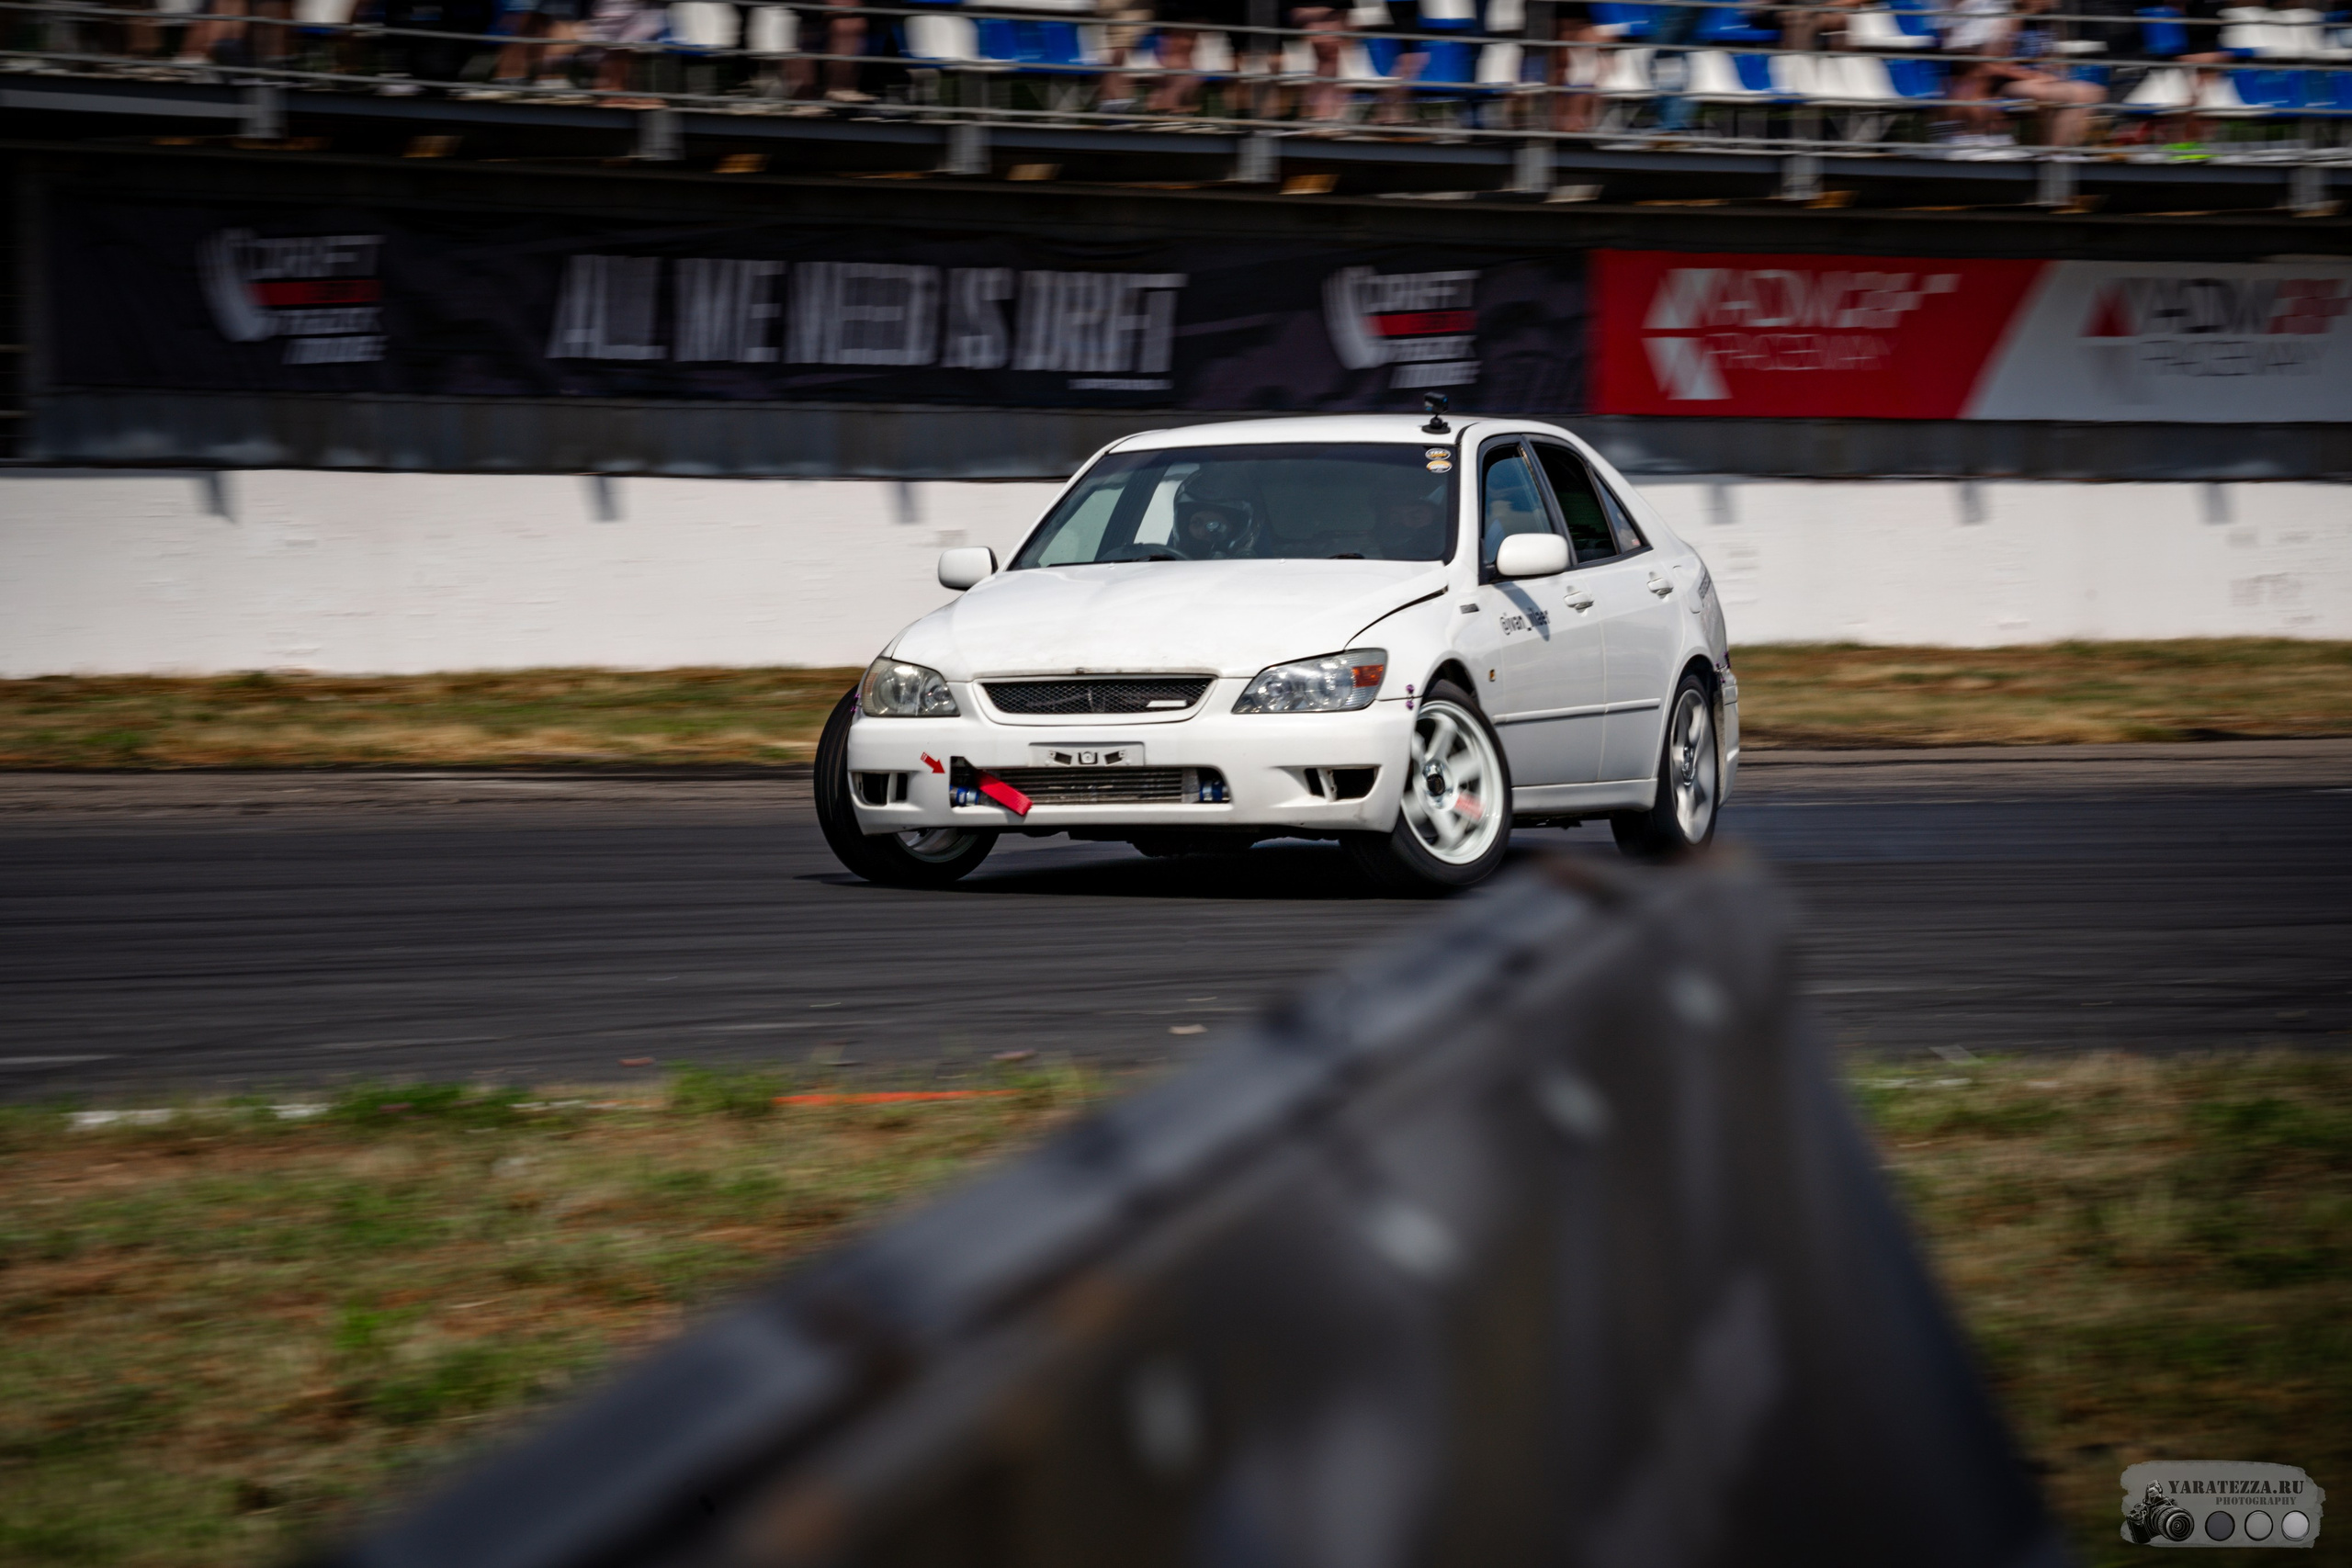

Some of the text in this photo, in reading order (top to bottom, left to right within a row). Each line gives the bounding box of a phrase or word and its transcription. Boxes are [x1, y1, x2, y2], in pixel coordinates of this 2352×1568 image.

[672, 258, 786, 364] WE
[783, 261, 944, 367] NEED
[941, 265, 1016, 370] IS
[1011, 269, 1189, 372] DRIFT
